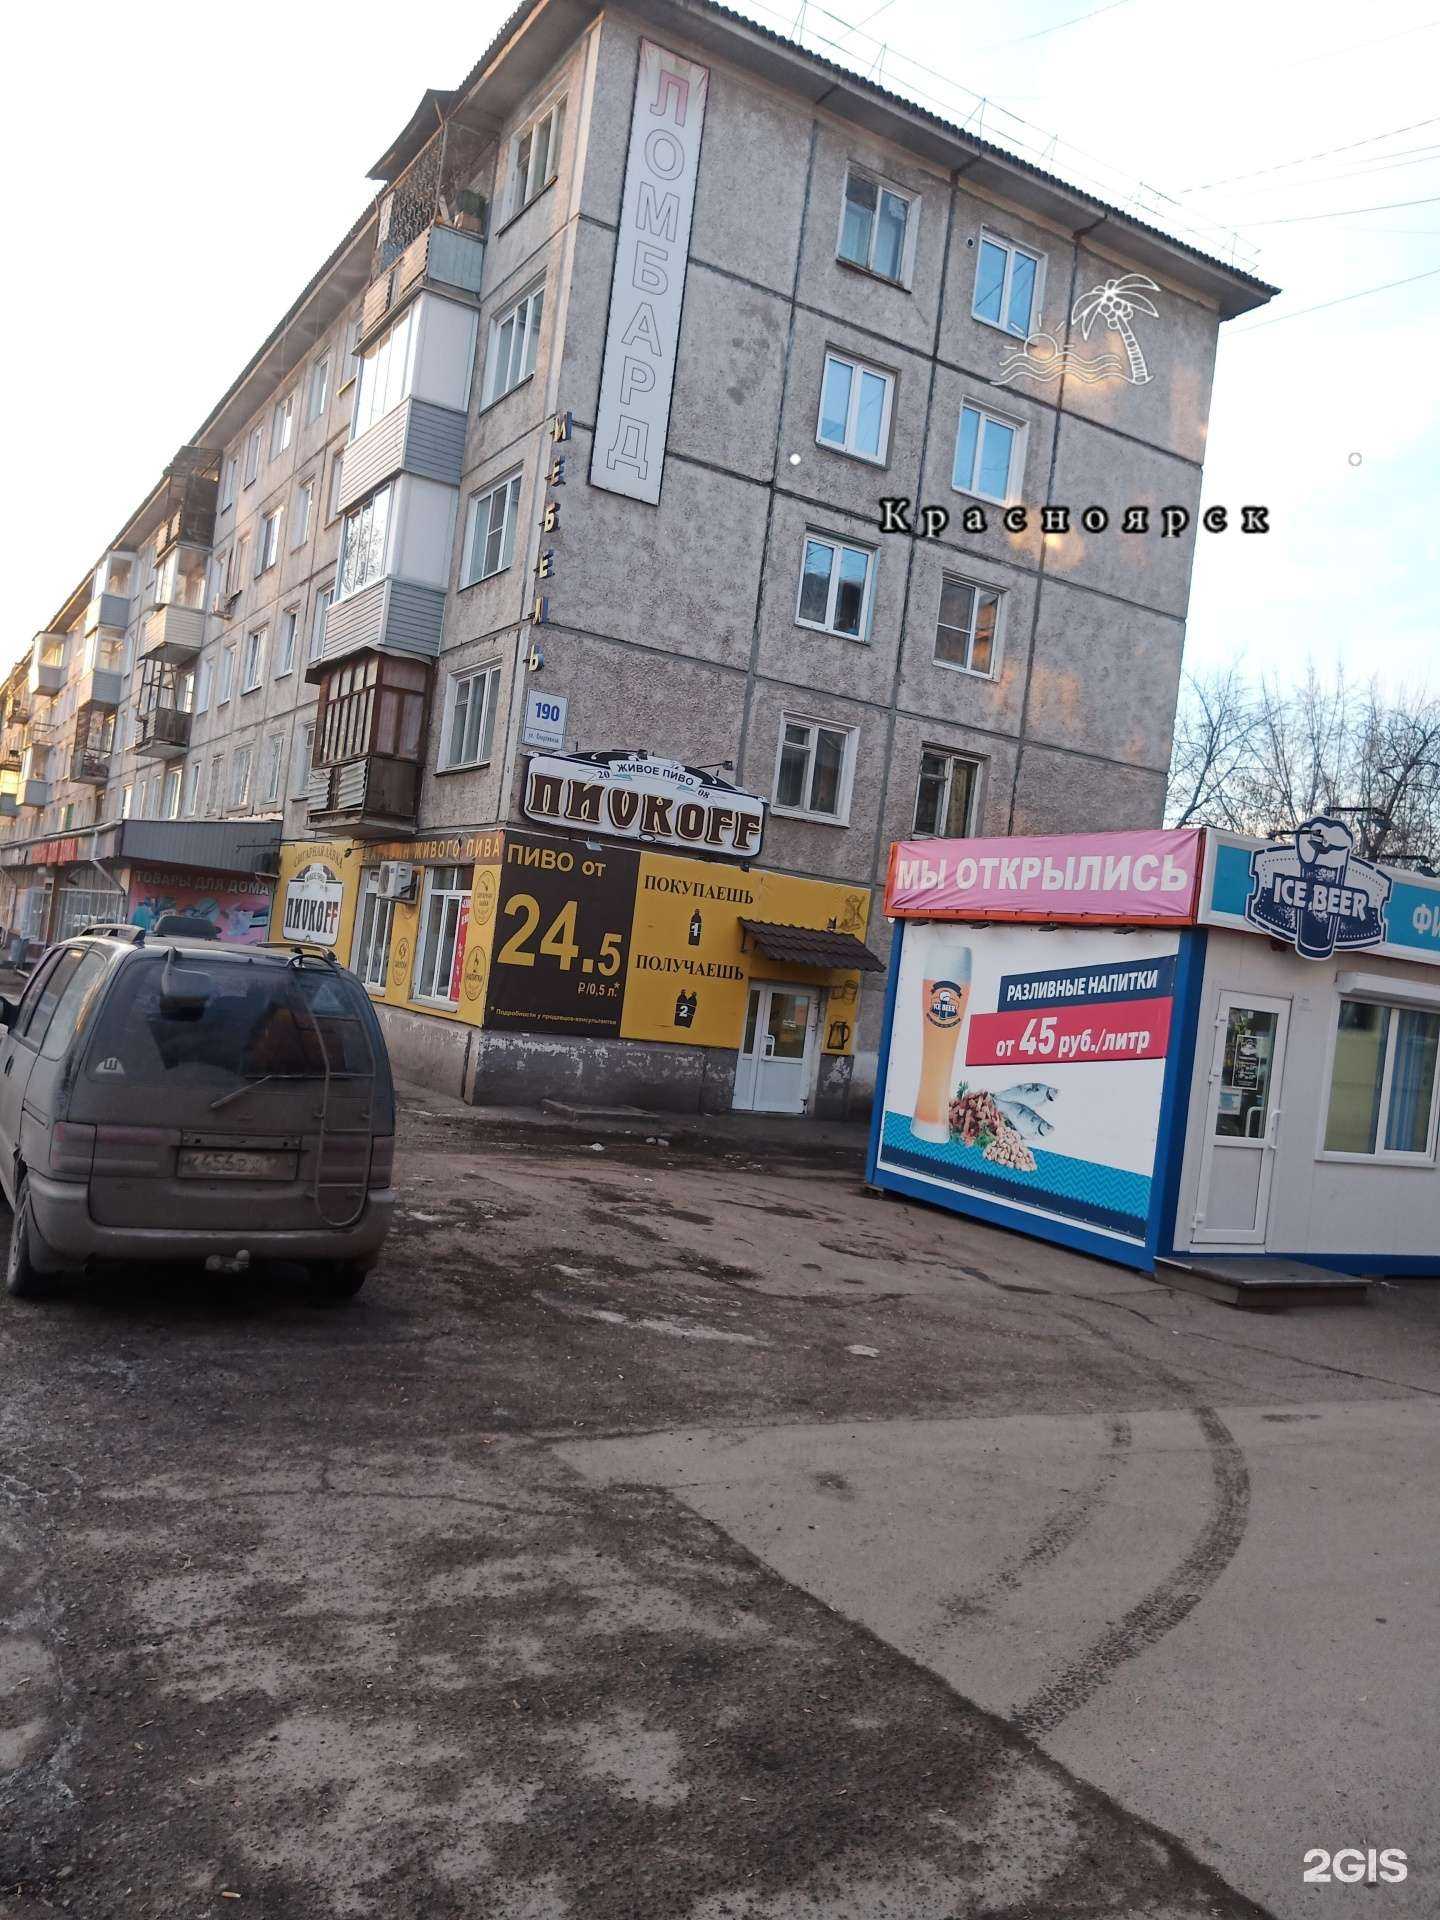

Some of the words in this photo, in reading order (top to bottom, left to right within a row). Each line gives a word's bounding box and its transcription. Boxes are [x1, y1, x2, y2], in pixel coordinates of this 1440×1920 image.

[606, 68, 691, 480] ЛОМБАРД
[528, 410, 573, 672] МЕБЕЛЬ
[535, 702, 560, 721] 190
[597, 770, 611, 779] 20
[616, 762, 660, 776] ЖИВОЕ
[662, 768, 694, 787] ПИВО
[415, 840, 461, 860] ЖИВОГО
[466, 838, 500, 858] ПИВА
[507, 843, 574, 872] ПИВО
[581, 860, 607, 878] от
[135, 869, 193, 888] ТОВАРЫ
[194, 874, 225, 890] ДЛЯ
[227, 881, 270, 897] ДОМА
[643, 874, 754, 904] ПОКУПАЕШЬ
[896, 857, 945, 890] МЫ
[956, 854, 1189, 893] ОТКРЫЛИСЬ
[1273, 877, 1307, 908] ICE
[1312, 885, 1368, 921] BEER
[497, 893, 623, 977] 24.5
[636, 954, 744, 981] ПОЛУЧАЕШЬ
[1006, 975, 1086, 1002] РАЗЛИВНЫЕ
[1088, 969, 1159, 994] НАПИТКИ
[995, 1038, 1015, 1057] от
[1018, 1016, 1058, 1055] 45
[1058, 1028, 1150, 1058] руб./литр
